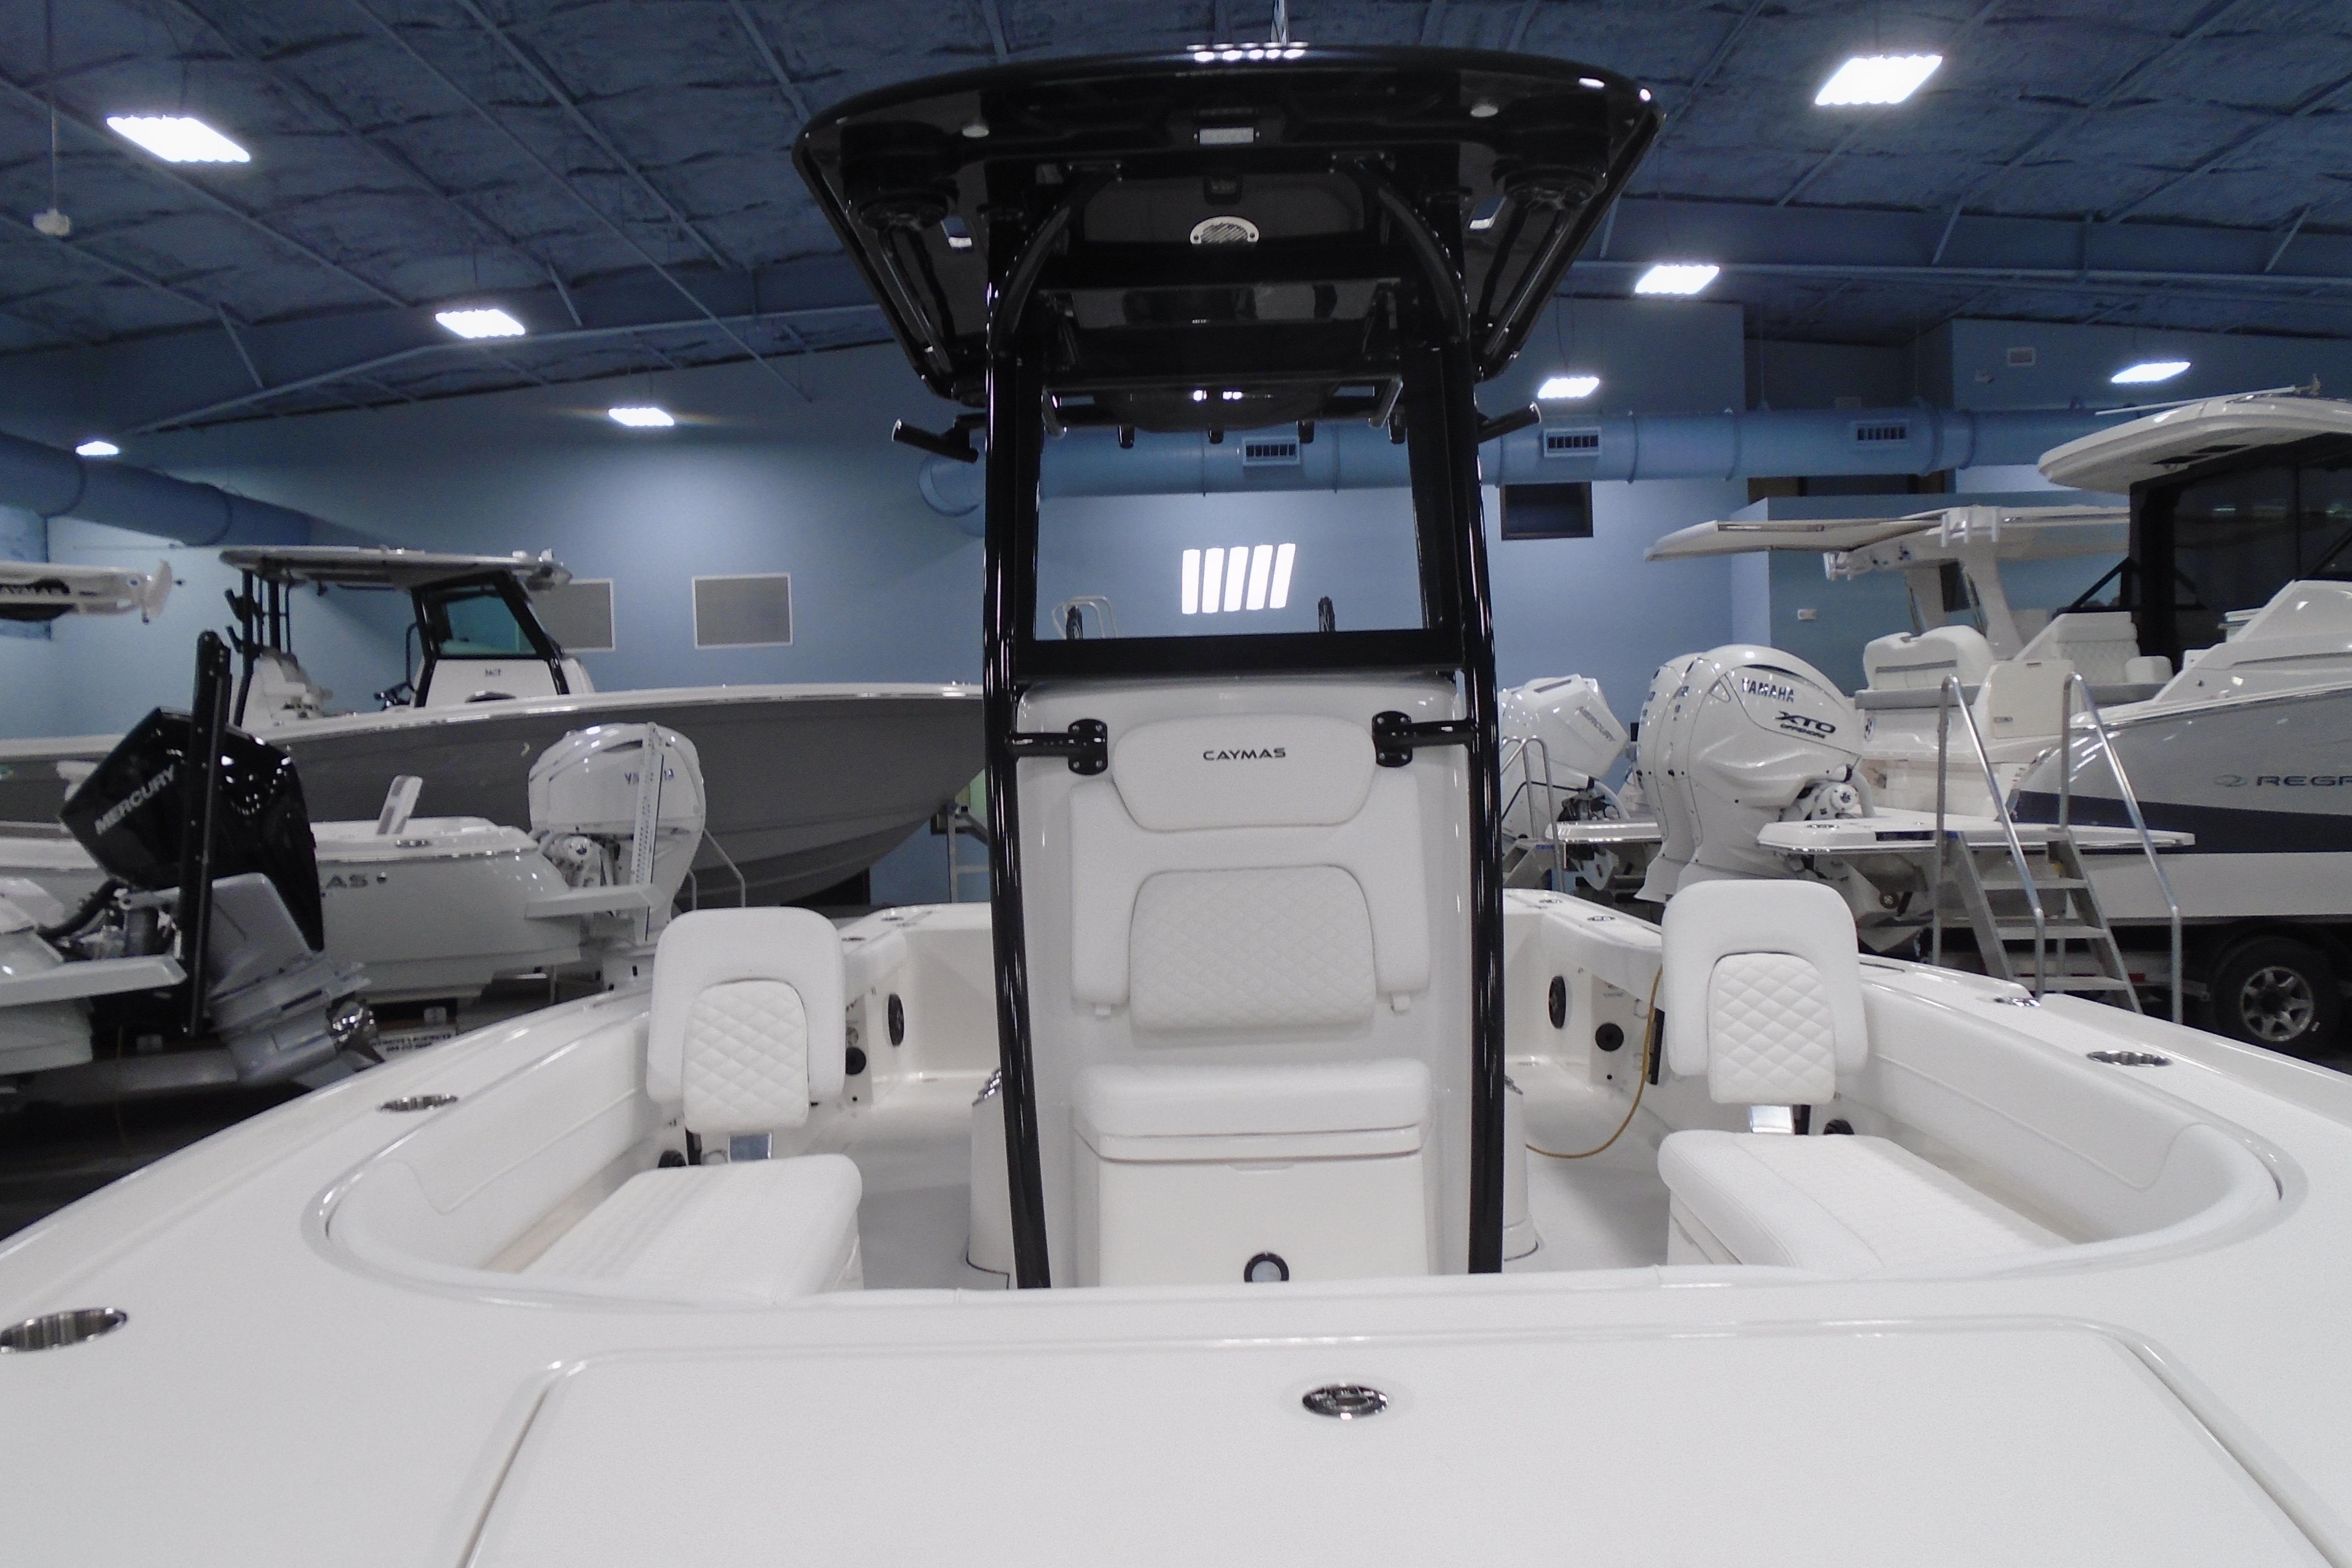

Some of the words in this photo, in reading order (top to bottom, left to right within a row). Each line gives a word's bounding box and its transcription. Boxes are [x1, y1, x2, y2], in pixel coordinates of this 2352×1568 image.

[1742, 677, 1794, 703] YAMAHA
[1774, 710, 1836, 734] XTO
[1203, 747, 1286, 760] CAYMAS
[94, 764, 174, 836] MERCURY
